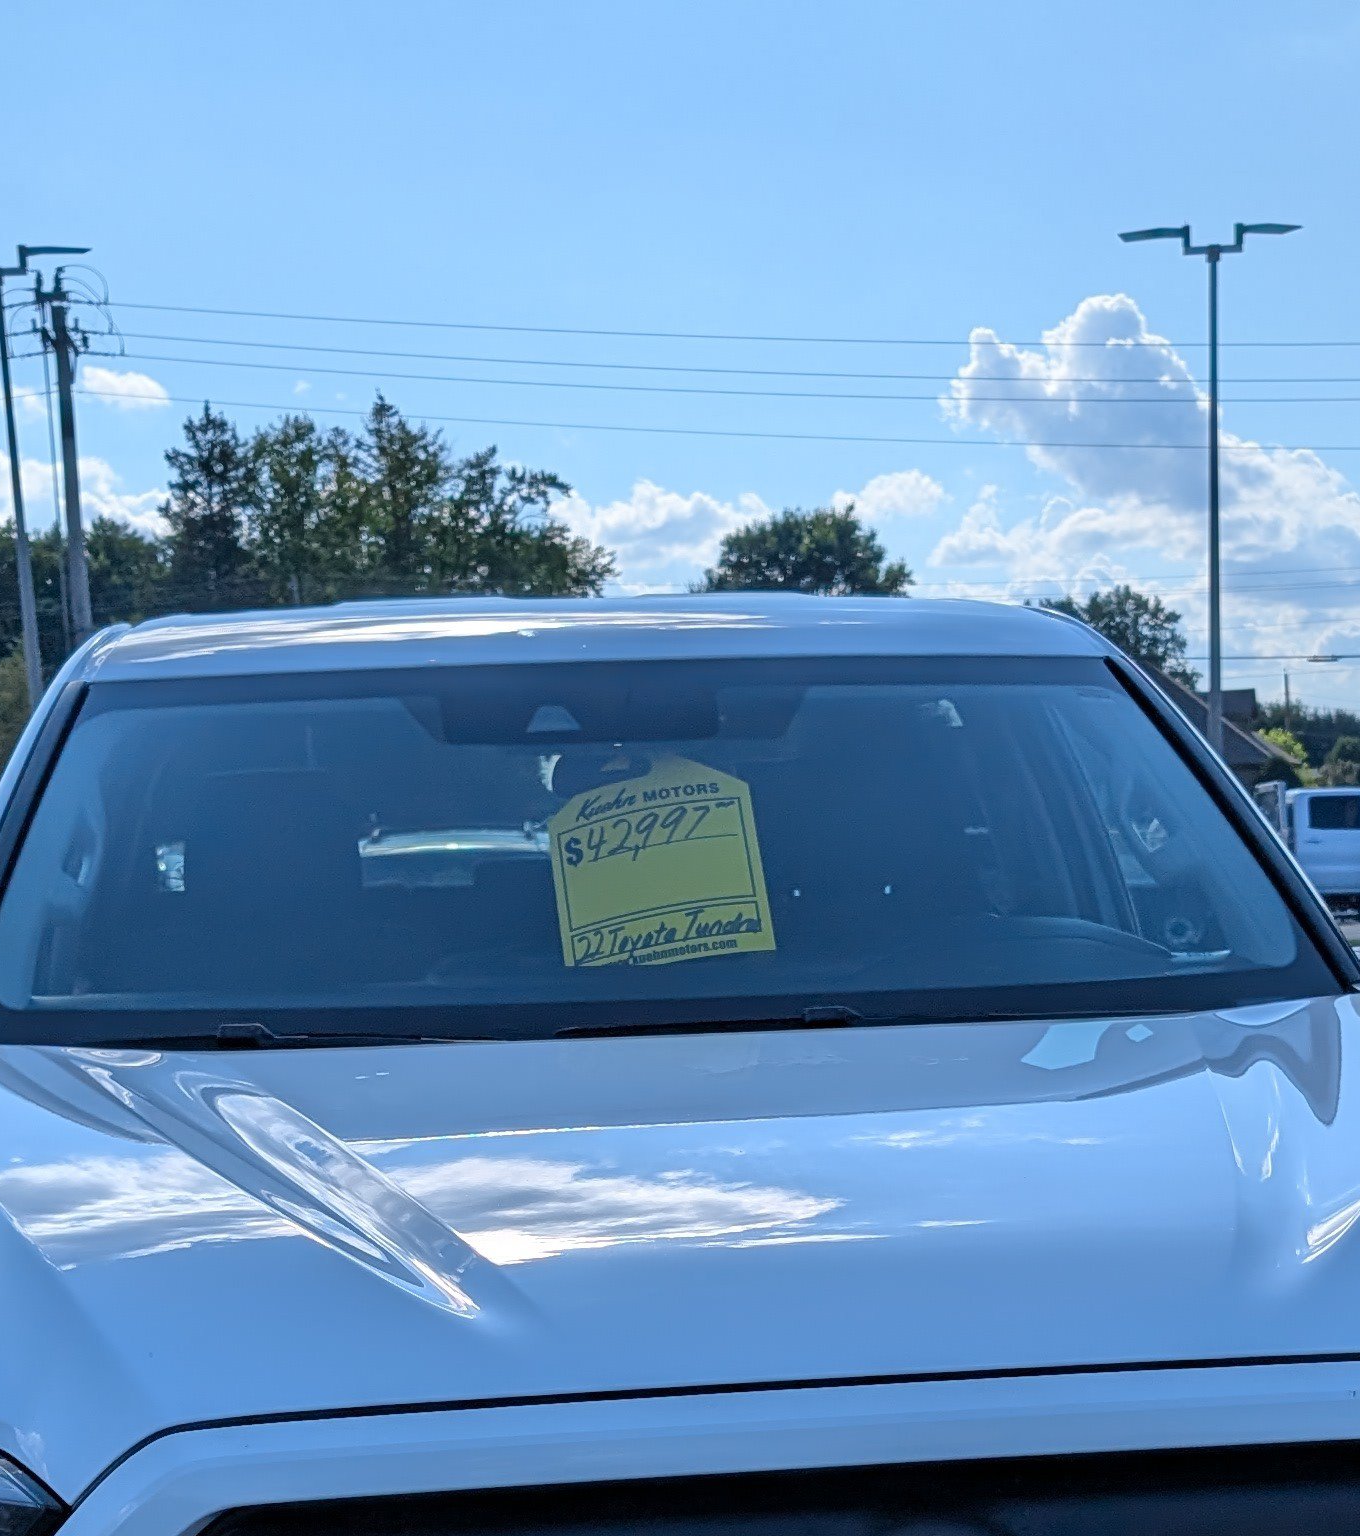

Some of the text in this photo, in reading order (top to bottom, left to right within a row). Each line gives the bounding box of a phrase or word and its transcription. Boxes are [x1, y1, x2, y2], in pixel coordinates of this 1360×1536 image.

[642, 782, 721, 803] MOTORS
[575, 929, 605, 966] 22
[607, 921, 677, 960] Toyota
